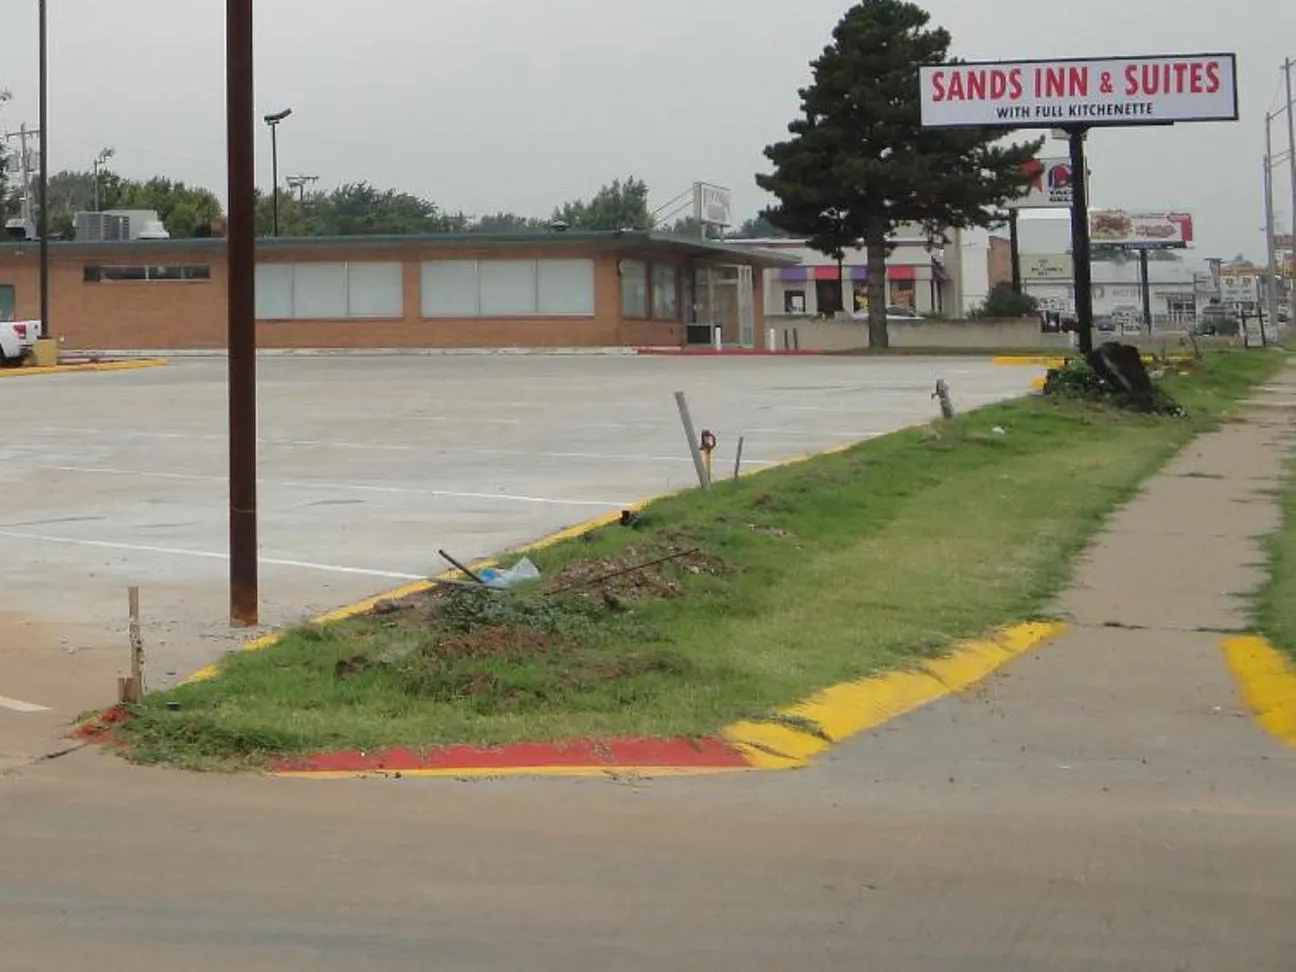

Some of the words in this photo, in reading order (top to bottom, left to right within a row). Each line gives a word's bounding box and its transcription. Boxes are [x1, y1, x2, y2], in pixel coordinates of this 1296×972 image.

[932, 68, 1023, 102] SANDS
[1034, 66, 1088, 98] INN
[1099, 71, 1113, 94] &
[1124, 61, 1220, 96] SUITES
[996, 105, 1030, 119] WITH
[1035, 105, 1064, 118] FULL
[1068, 102, 1153, 118] KITCHENETTE
